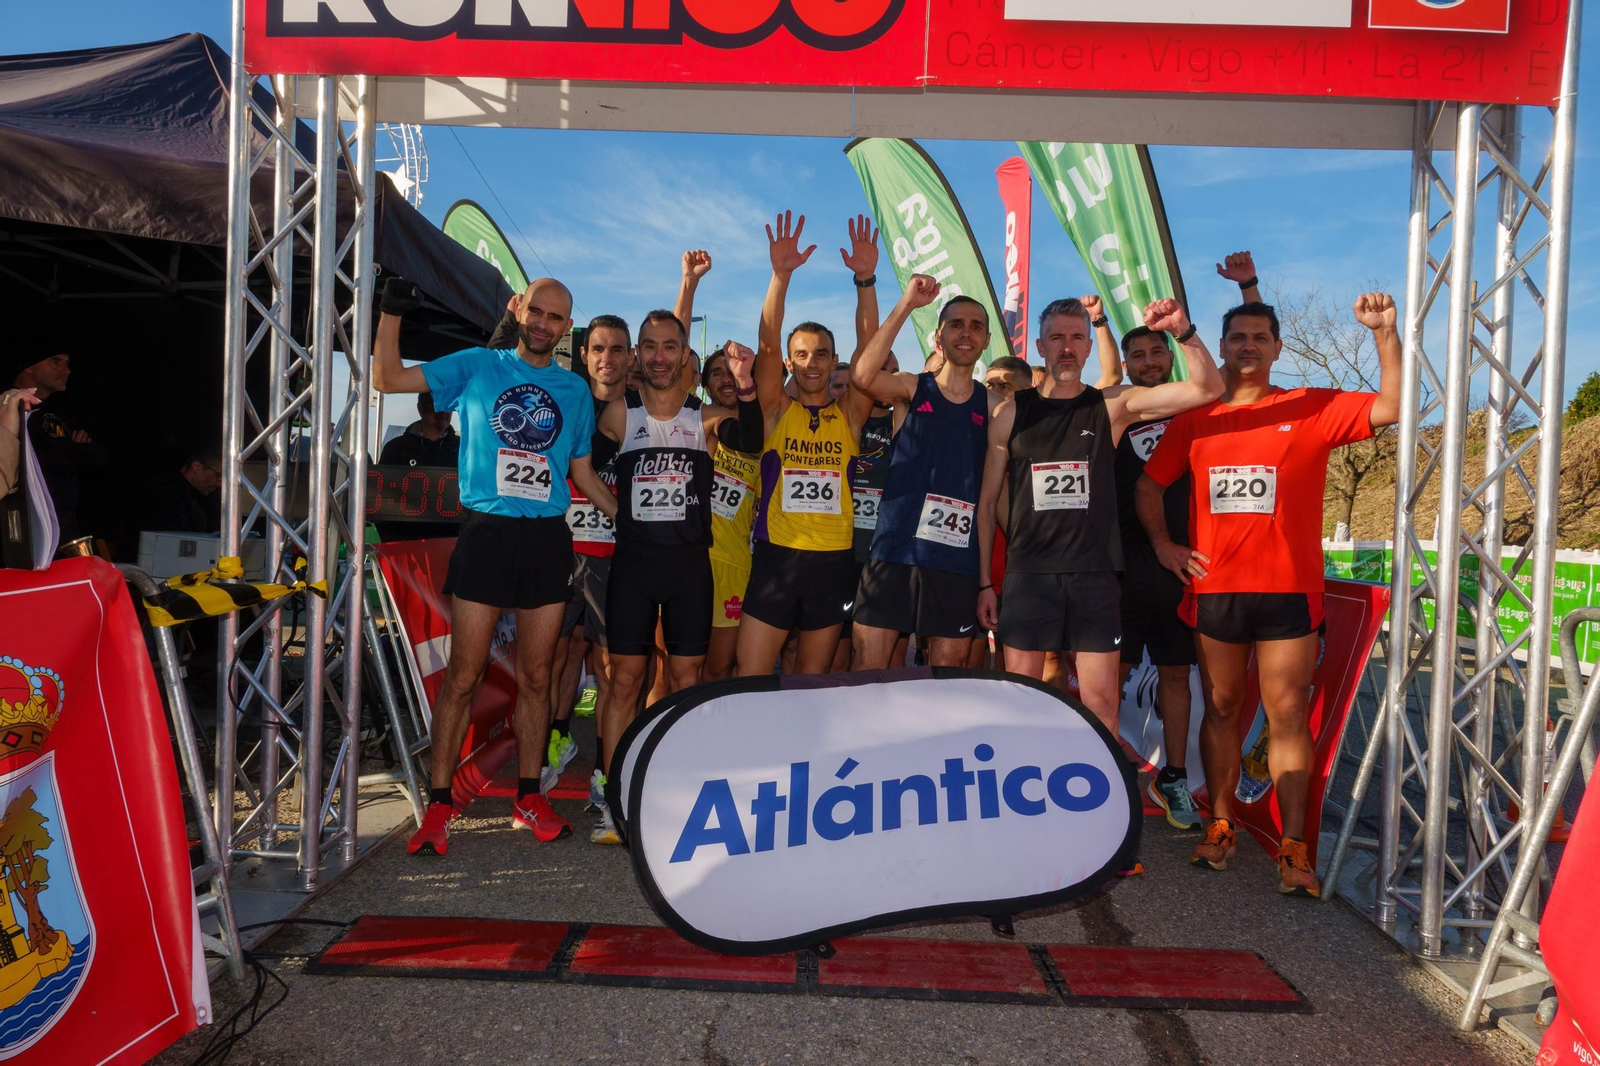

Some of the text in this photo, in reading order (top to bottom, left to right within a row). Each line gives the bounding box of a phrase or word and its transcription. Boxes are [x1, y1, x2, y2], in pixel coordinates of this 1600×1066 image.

[945, 30, 1103, 70] Cáncer
[1144, 36, 1242, 82] Vigo
[1265, 40, 1328, 77] +11
[1373, 43, 1421, 80] La
[1441, 44, 1485, 83] 21
[498, 386, 552, 405] ADN RUNNERS
[504, 433, 518, 446] AND
[785, 437, 843, 455] TANINOS
[784, 452, 841, 466] PONTEAREAS
[504, 462, 552, 488] 224
[1044, 474, 1086, 495] 221
[639, 487, 685, 508] 226
[790, 480, 834, 501] 236
[1216, 478, 1267, 499] 220
[853, 498, 879, 517] 23
[572, 510, 614, 530] 233
[927, 508, 971, 535] 243
[669, 743, 1111, 864] Atlántico
